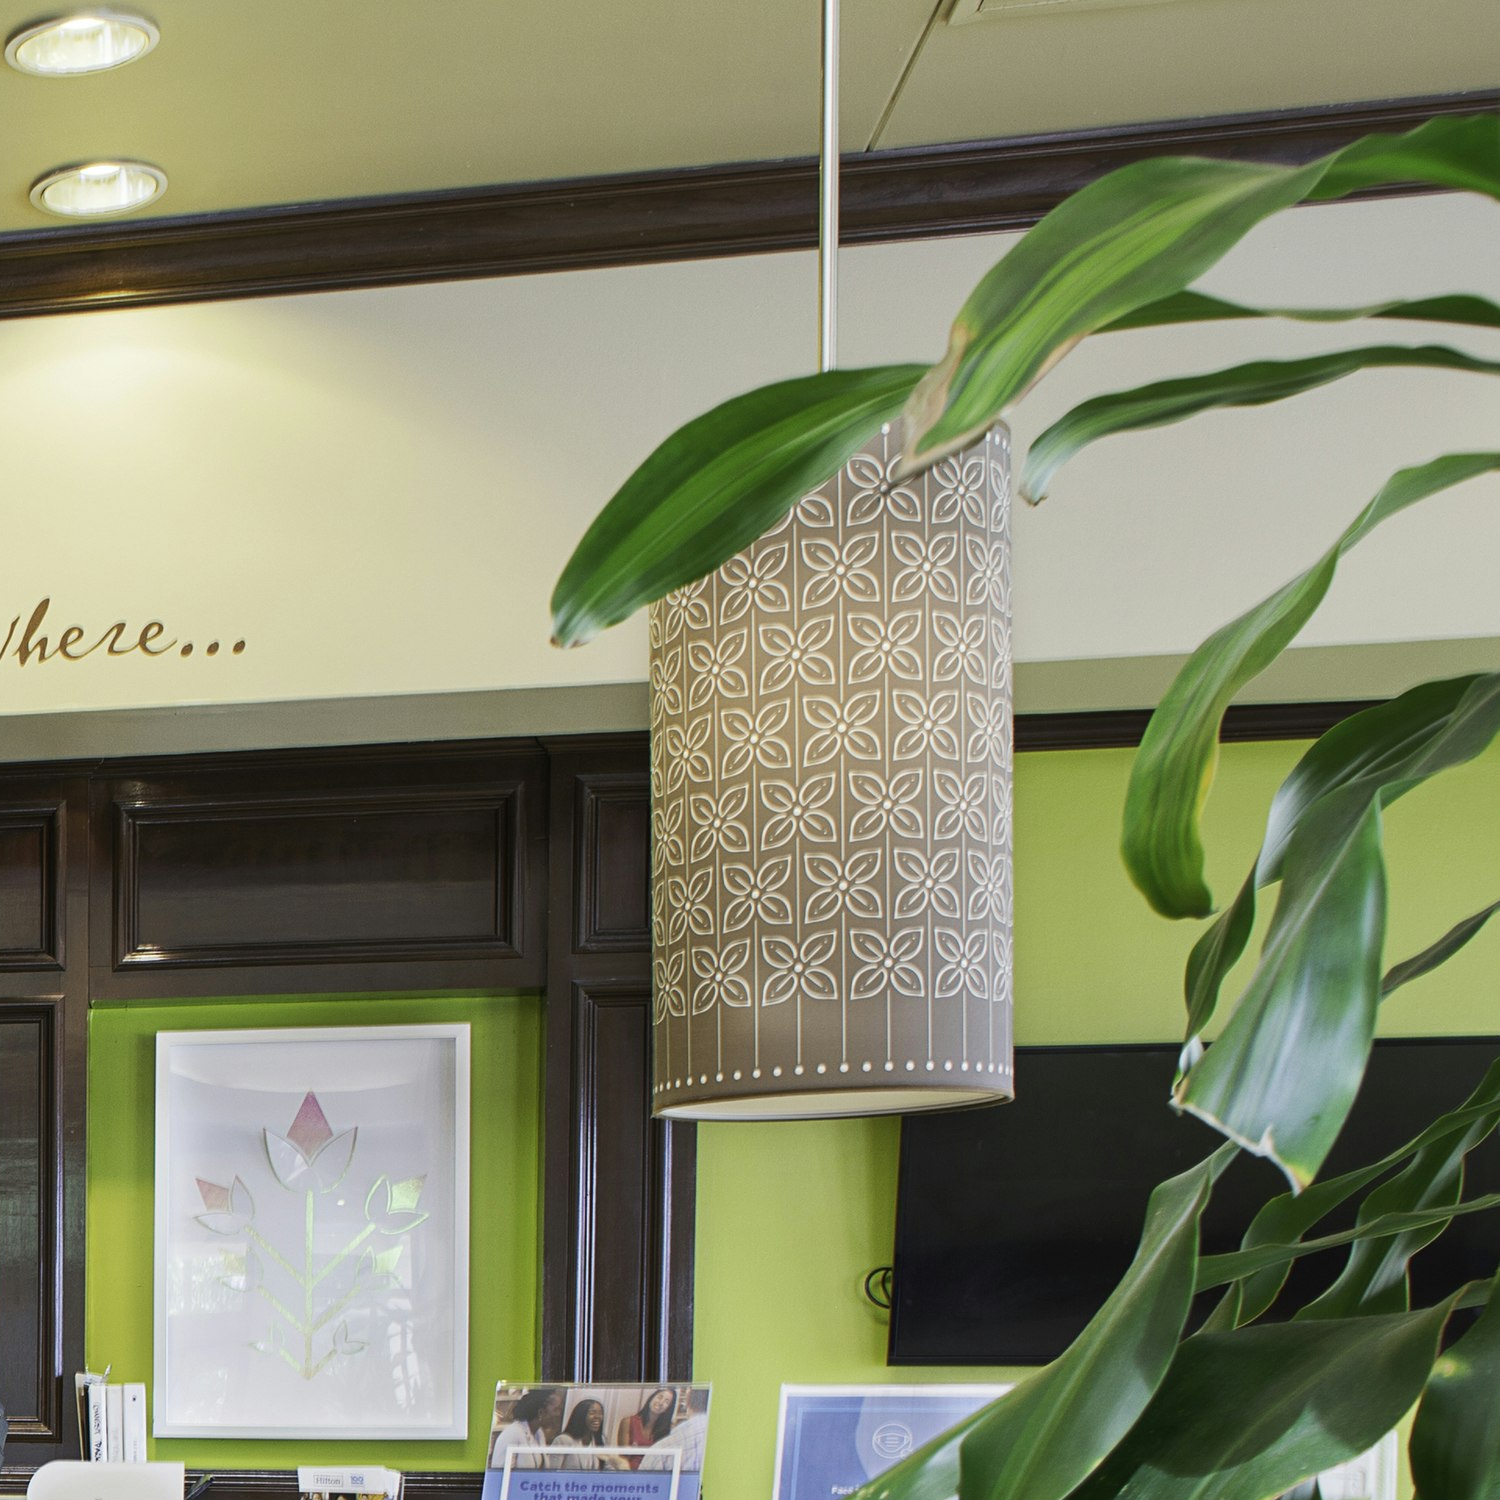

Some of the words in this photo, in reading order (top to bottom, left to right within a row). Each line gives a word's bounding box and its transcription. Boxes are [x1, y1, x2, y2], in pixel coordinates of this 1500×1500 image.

[315, 1476, 342, 1486] Hilton
[520, 1480, 561, 1492] Catch
[564, 1482, 588, 1493] the
[591, 1483, 659, 1494] moments
